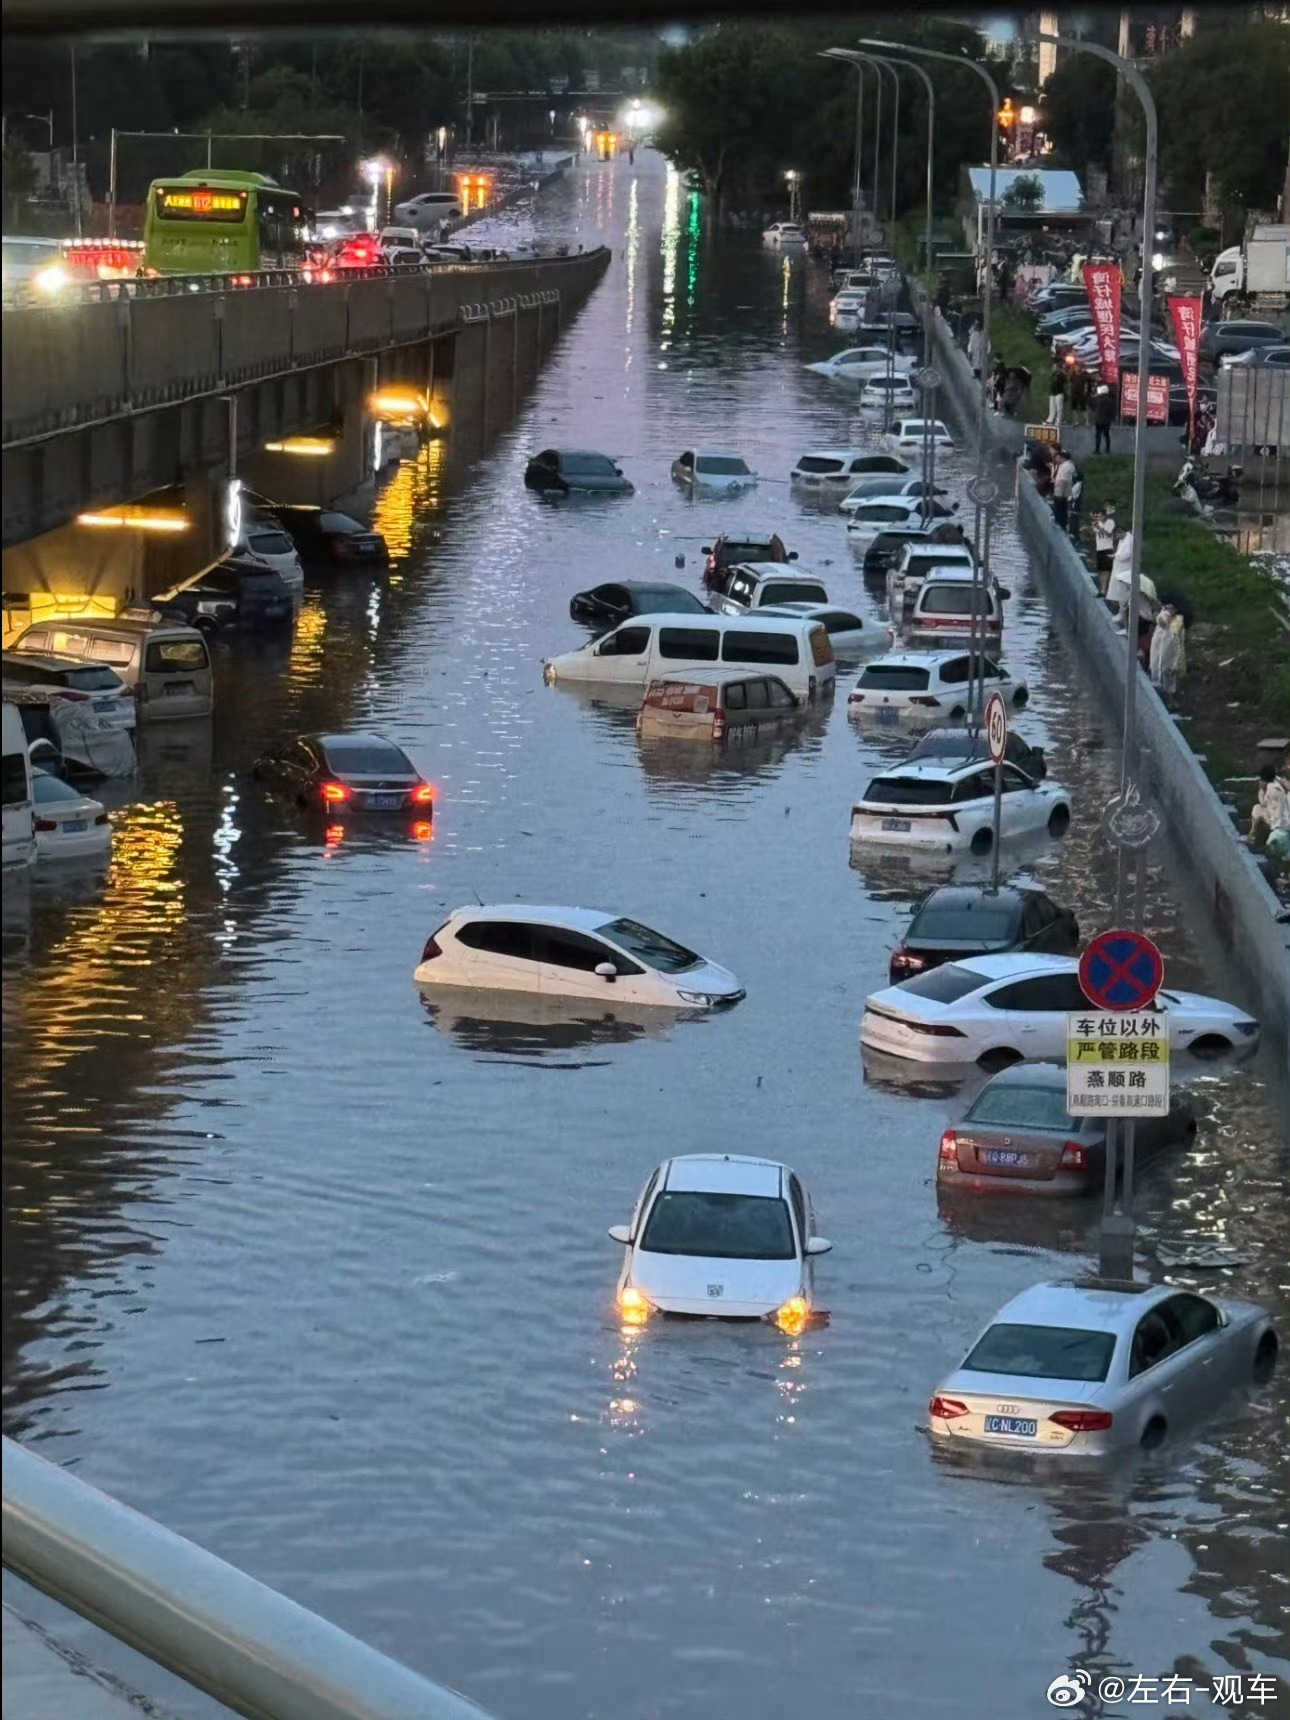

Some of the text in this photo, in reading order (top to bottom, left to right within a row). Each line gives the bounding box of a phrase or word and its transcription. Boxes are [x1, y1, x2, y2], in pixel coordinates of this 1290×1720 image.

[991, 711, 1003, 744] 60
[1076, 1018, 1160, 1037] 车位以外
[1076, 1042, 1160, 1060] 严管路段
[1087, 1070, 1147, 1088] 燕顺路
